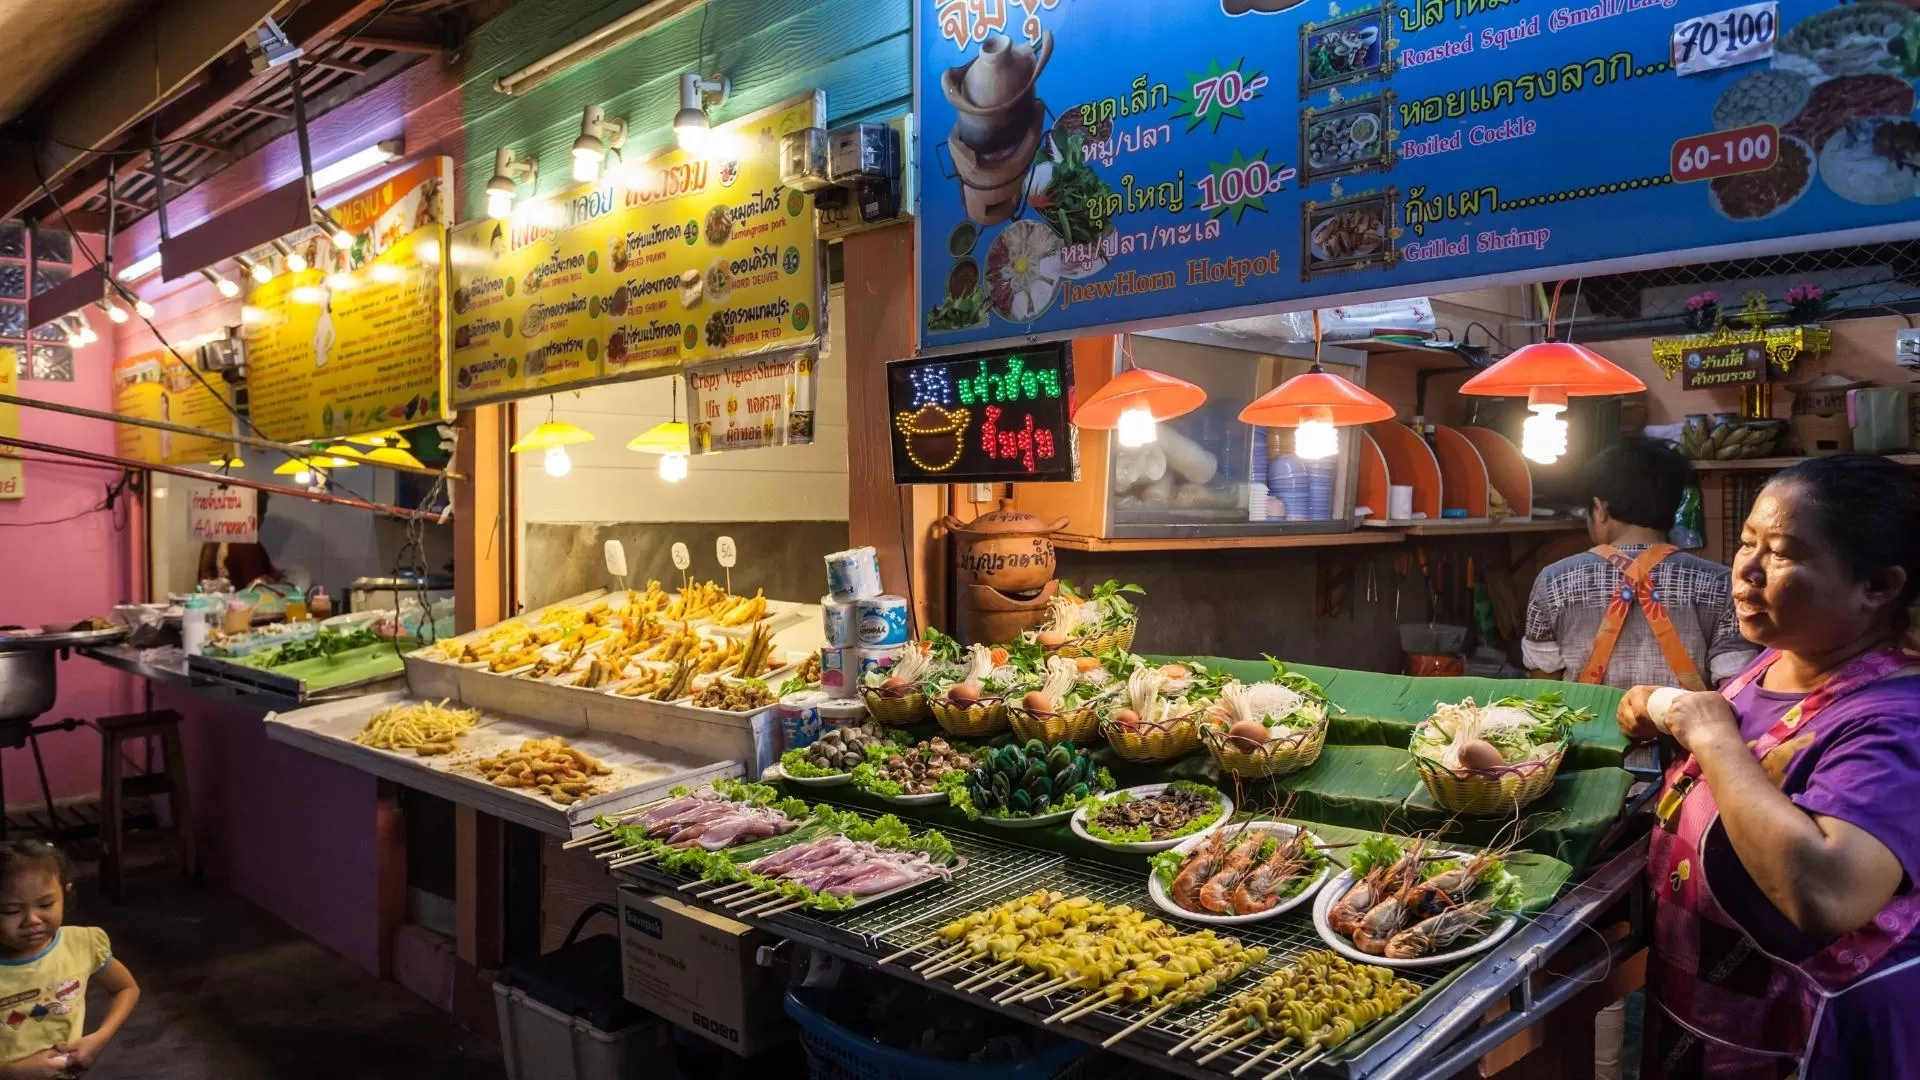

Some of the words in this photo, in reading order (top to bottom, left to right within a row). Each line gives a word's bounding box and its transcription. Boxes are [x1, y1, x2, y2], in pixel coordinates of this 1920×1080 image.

[1402, 34, 1473, 68] Roasted
[1481, 16, 1540, 49] Squid
[1679, 10, 1773, 62] 70-100
[1080, 75, 1169, 136] ชุดเล็ก
[1081, 123, 1171, 168] หมู/ปลา
[1403, 129, 1461, 159] Boiled
[1469, 116, 1536, 147] Cockle
[1678, 134, 1771, 173] 60-100
[342, 191, 380, 228] MENU
[1086, 169, 1184, 230] ชุดใหญ่
[771, 217, 786, 233] pork
[1404, 236, 1469, 262] Grilled
[1477, 227, 1550, 253] Shrimp
[1187, 249, 1280, 291] Hotpot
[761, 327, 782, 340] FRIED
[690, 372, 721, 392] Crispy
